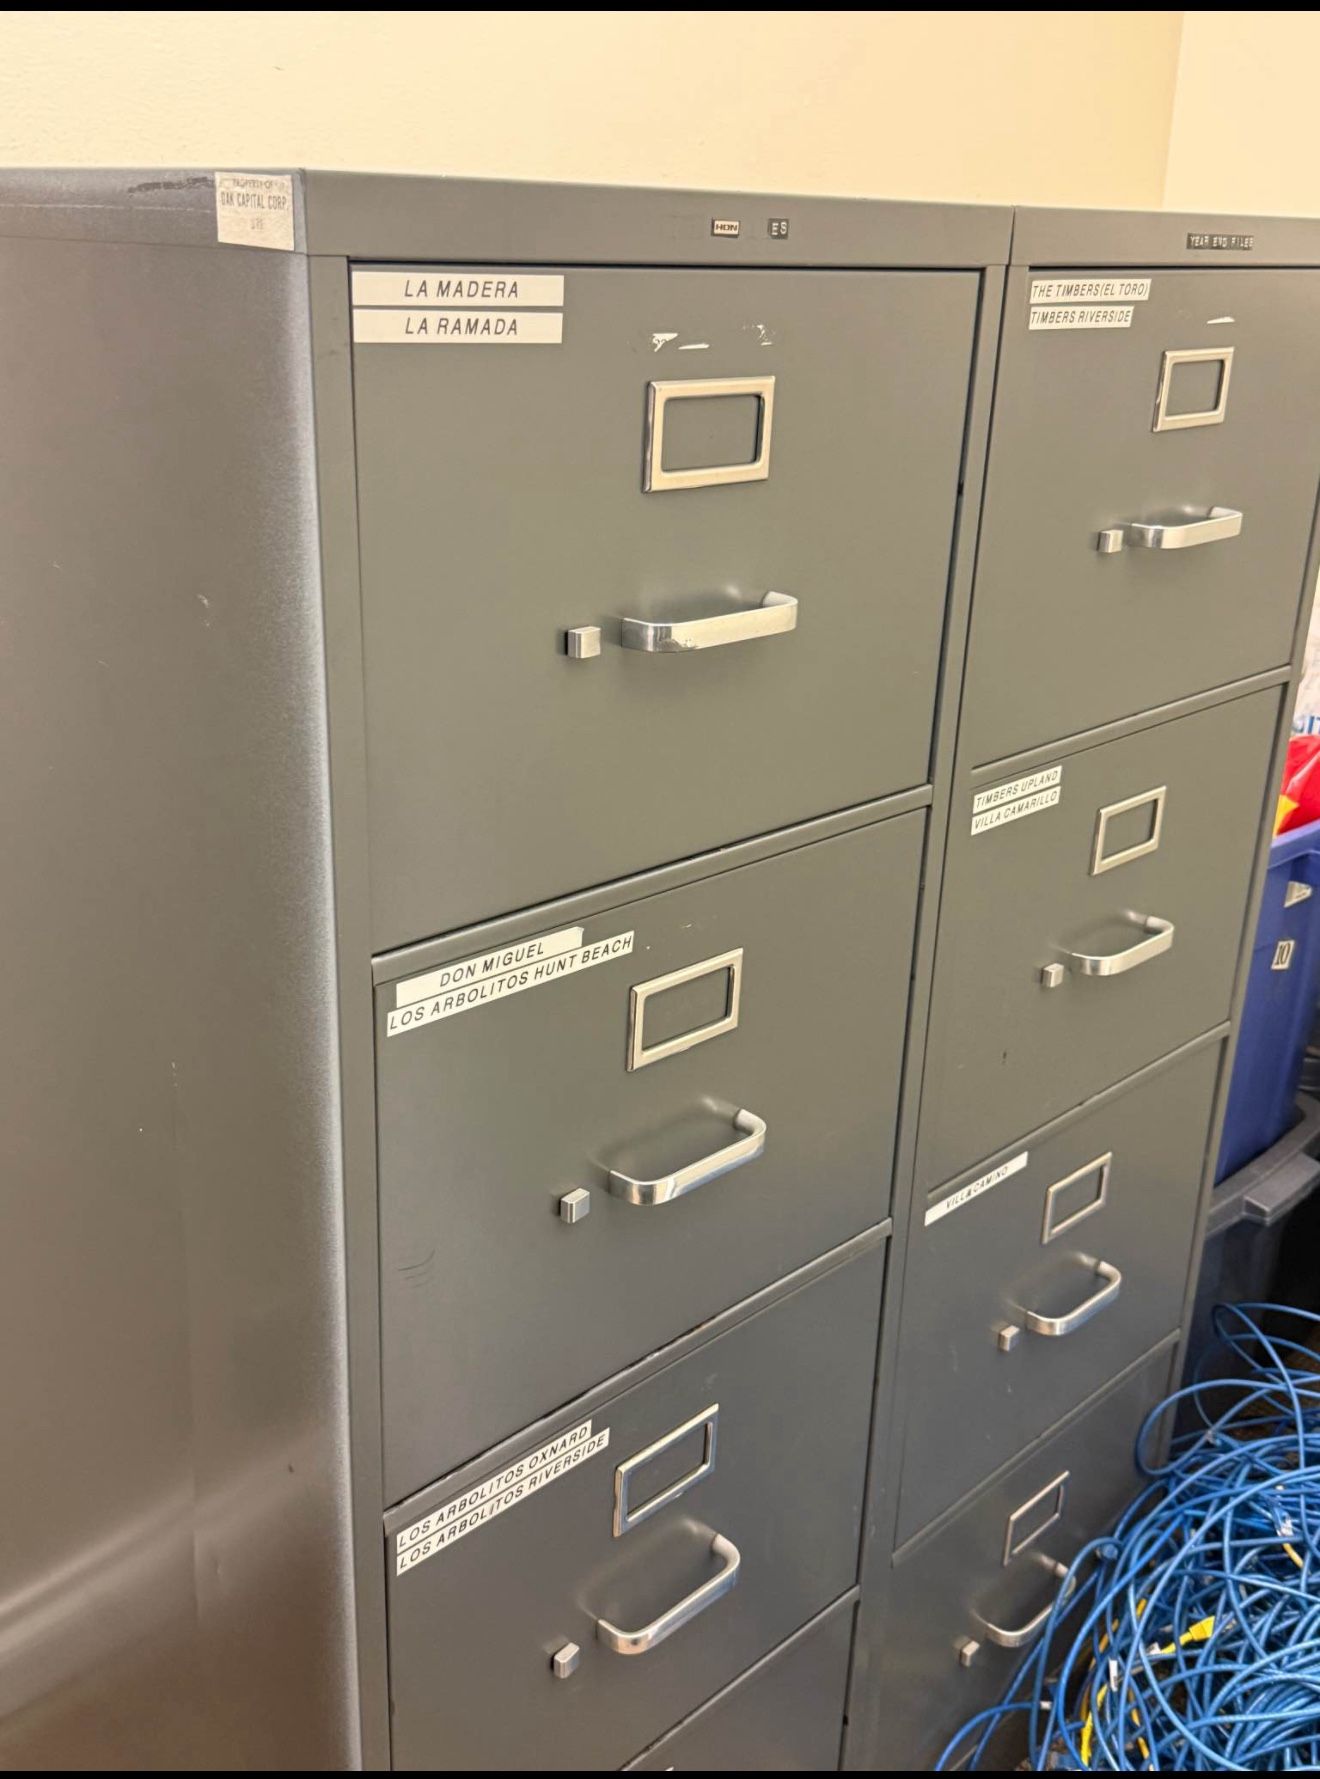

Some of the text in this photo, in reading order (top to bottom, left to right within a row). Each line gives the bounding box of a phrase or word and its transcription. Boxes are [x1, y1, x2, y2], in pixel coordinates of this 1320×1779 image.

[221, 191, 234, 207] OAK
[237, 192, 265, 209] CAPITAL
[715, 223, 738, 232] HON
[771, 221, 787, 236] ES
[1190, 235, 1209, 247] YEAR
[1212, 236, 1228, 248] END
[404, 279, 519, 299] LA MADERA
[1033, 285, 1053, 298] THE
[1119, 282, 1149, 297] TORO)
[404, 317, 519, 336] LA RAMADA
[1031, 310, 1132, 324] TIMBERS RIVERSIDE
[976, 770, 1058, 809] TIMBERS UPLAND
[975, 790, 1058, 829] VILLA CAMARILLO
[440, 942, 545, 987] DON MIGUEL
[390, 935, 632, 1030] LOS ARBOLITOS HUNT BEACH
[399, 1426, 588, 1548] LOS ARBOLITOS OXNARD
[400, 1434, 605, 1569] LOS ARBOLITOS RIVERSIDE
